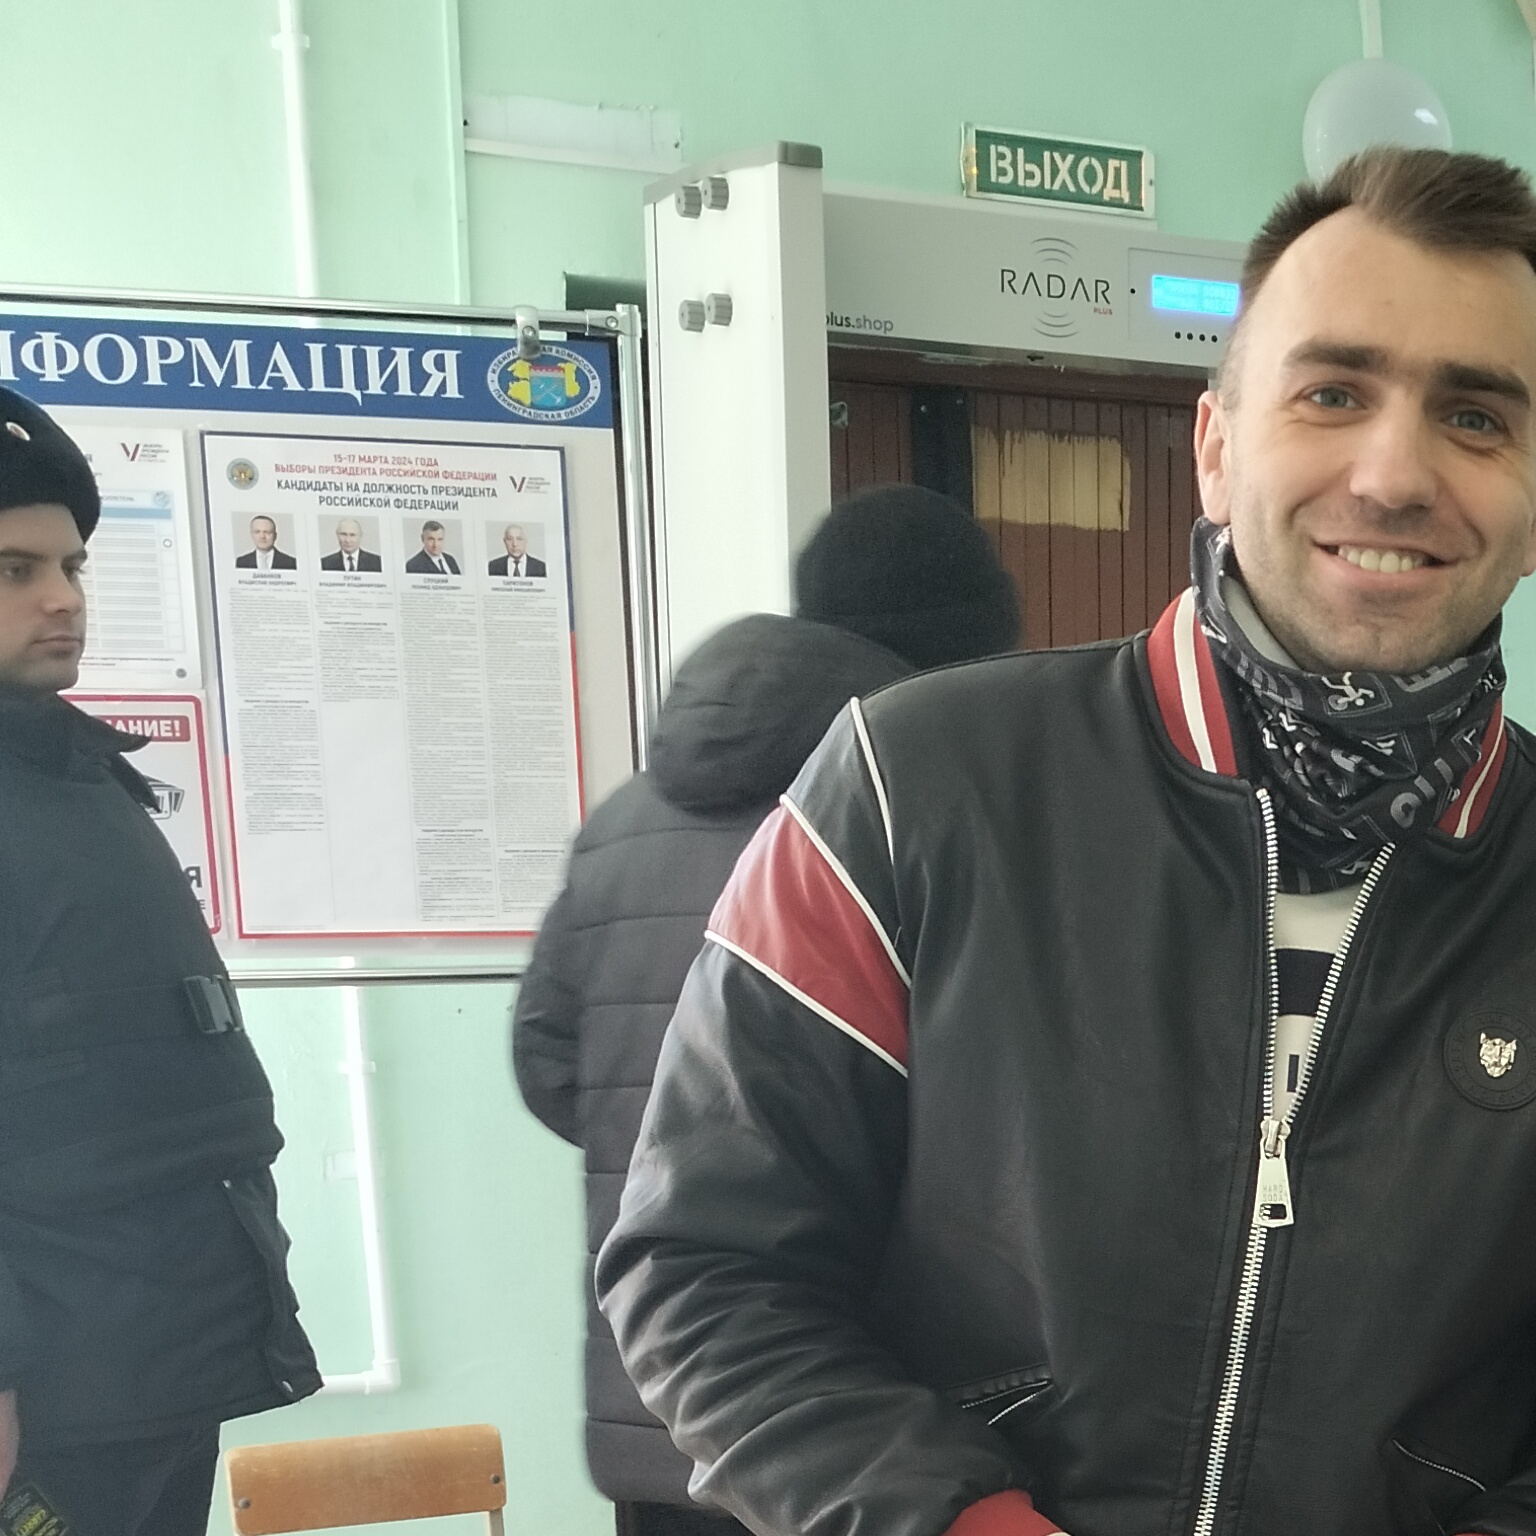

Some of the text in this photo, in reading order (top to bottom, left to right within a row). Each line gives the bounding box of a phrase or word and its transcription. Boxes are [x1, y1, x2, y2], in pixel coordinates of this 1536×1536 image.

[988, 143, 1131, 203] ВЫХОД
[1000, 267, 1112, 305] RADAR
[1093, 306, 1113, 316] PLUS
[333, 454, 439, 467] 15-17 МАРТА 2024 ГОДА
[274, 463, 497, 481] ВЫБОРЫ ПРЕЗИДЕНТА РОССИЙСКОЙ ФЕДЕРАЦИИ
[277, 479, 498, 498] КАНДИДАТЫ НА ДОЛЖНОСТЬ ПРЕЗИДЕНТА
[318, 494, 459, 511] РОССИЙСКОЙ ФЕДЕРАЦИИ
[105, 719, 181, 737] АНИЕ!
